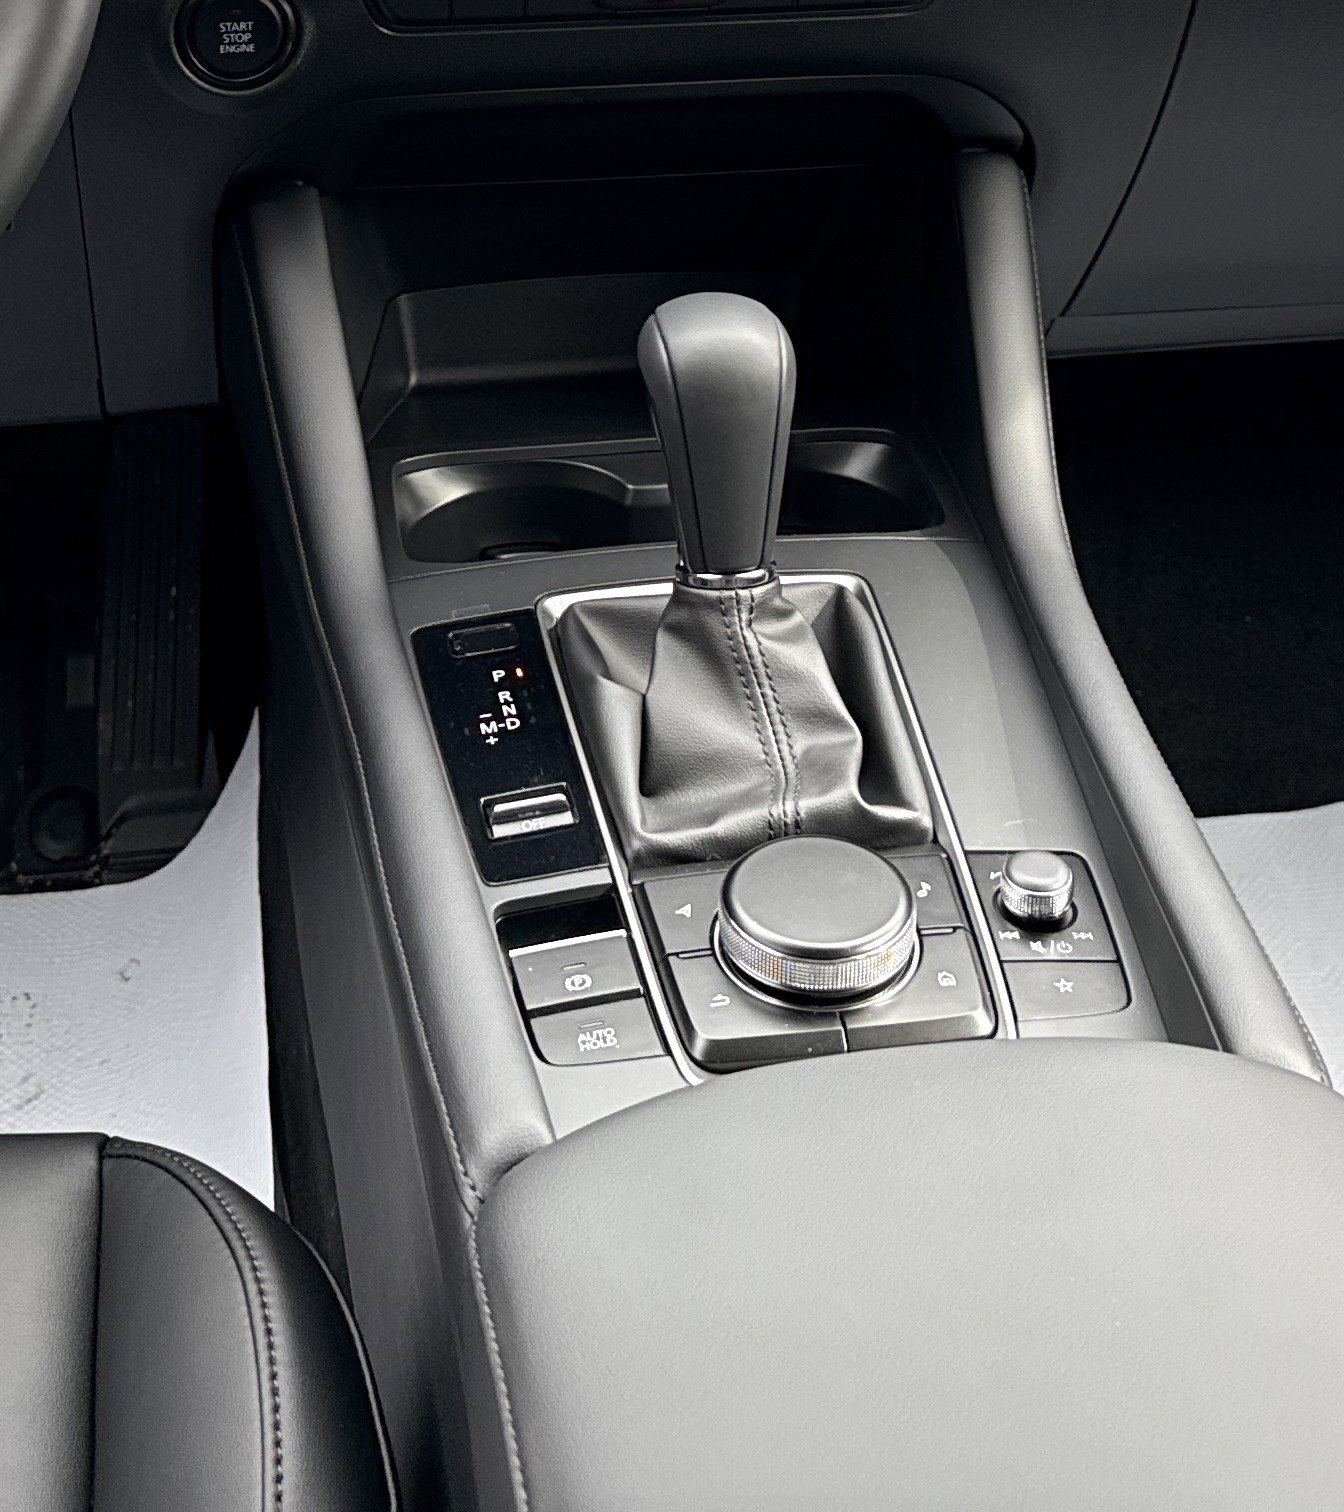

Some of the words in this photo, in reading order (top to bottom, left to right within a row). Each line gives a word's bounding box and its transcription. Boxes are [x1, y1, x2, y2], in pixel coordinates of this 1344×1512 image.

[219, 22, 254, 32] START
[223, 33, 252, 44] STOP
[219, 43, 256, 54] ENGINE
[492, 670, 506, 683] P
[498, 691, 513, 703] R
[501, 703, 517, 717] N
[578, 1028, 616, 1043] AUTO
